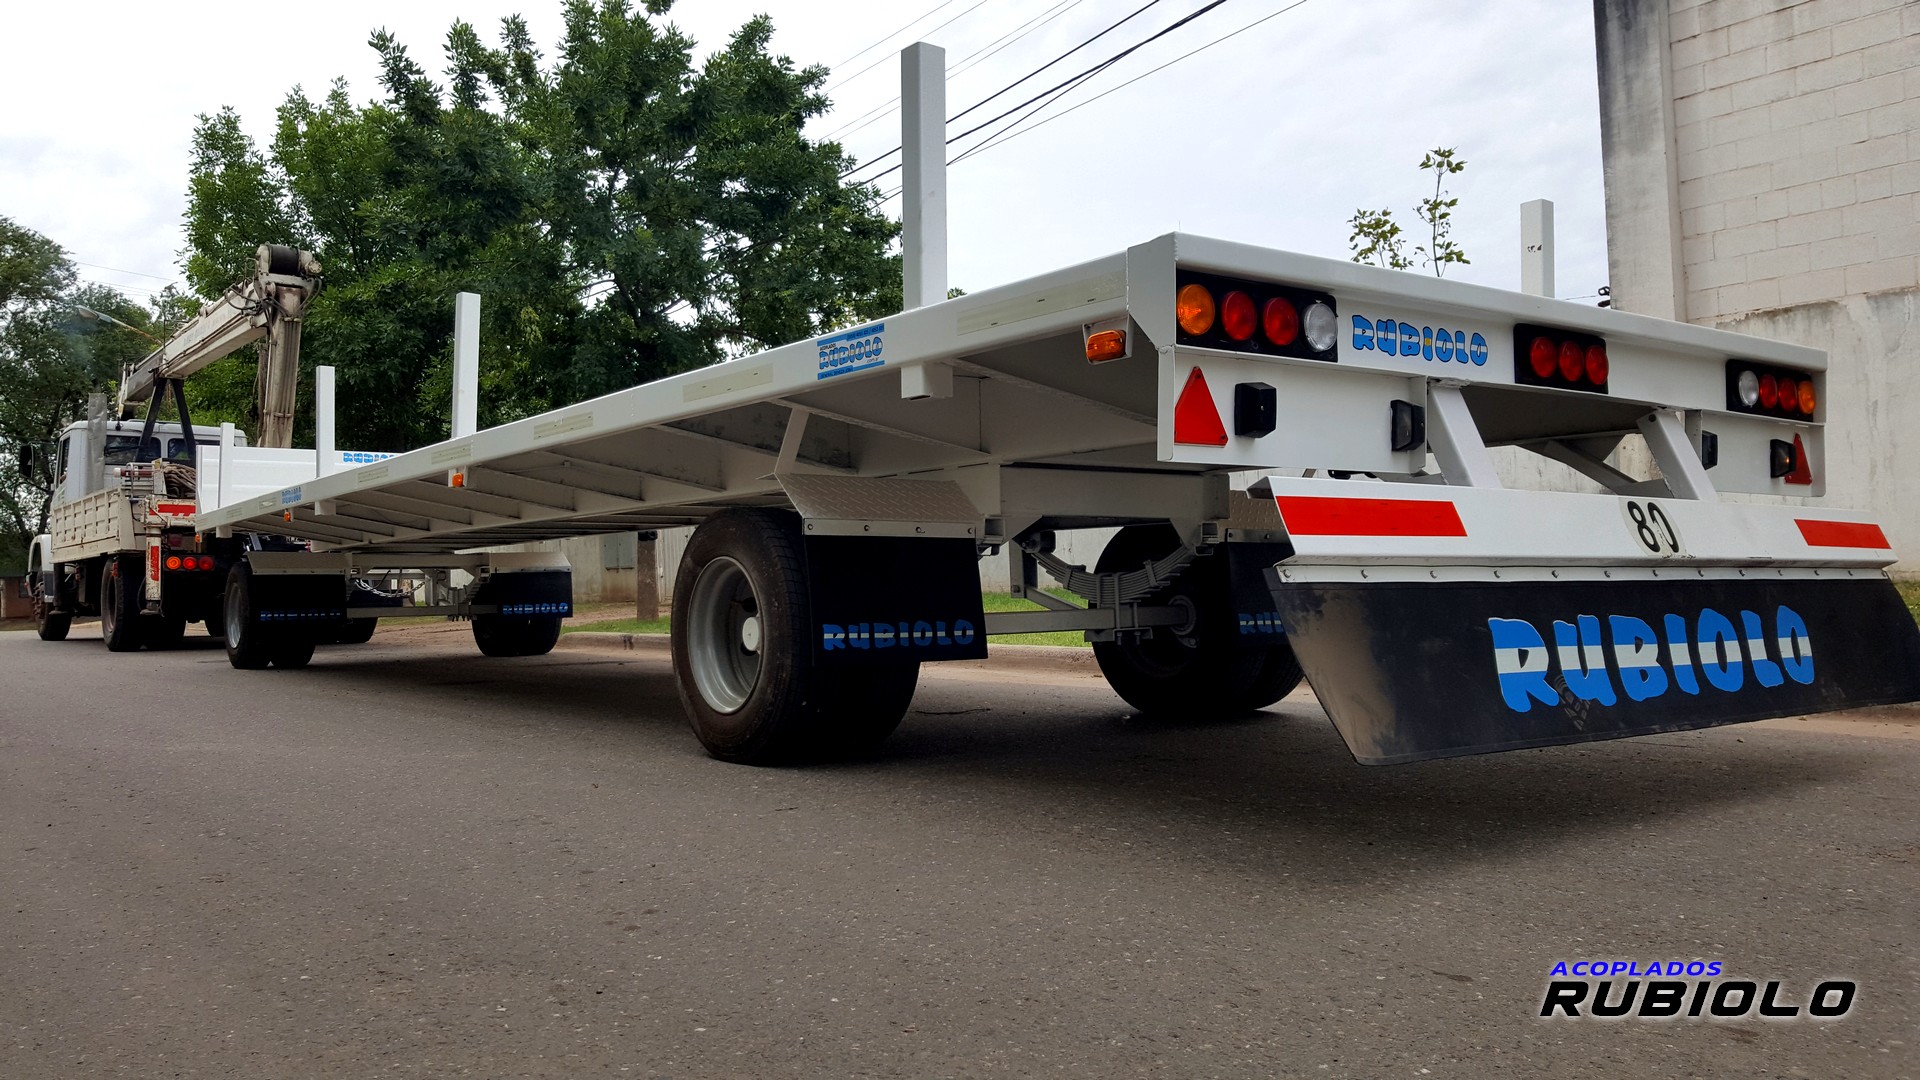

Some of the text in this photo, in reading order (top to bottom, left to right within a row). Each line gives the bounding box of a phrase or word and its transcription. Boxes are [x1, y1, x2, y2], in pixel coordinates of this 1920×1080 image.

[819, 336, 883, 369] RUBIOLO
[1352, 315, 1488, 366] RUBIOLO
[1627, 500, 1680, 553] 80
[503, 602, 568, 615] RUBIOLO
[823, 619, 974, 650] RUBIOLO
[1488, 605, 1815, 712] RUBIOLO
